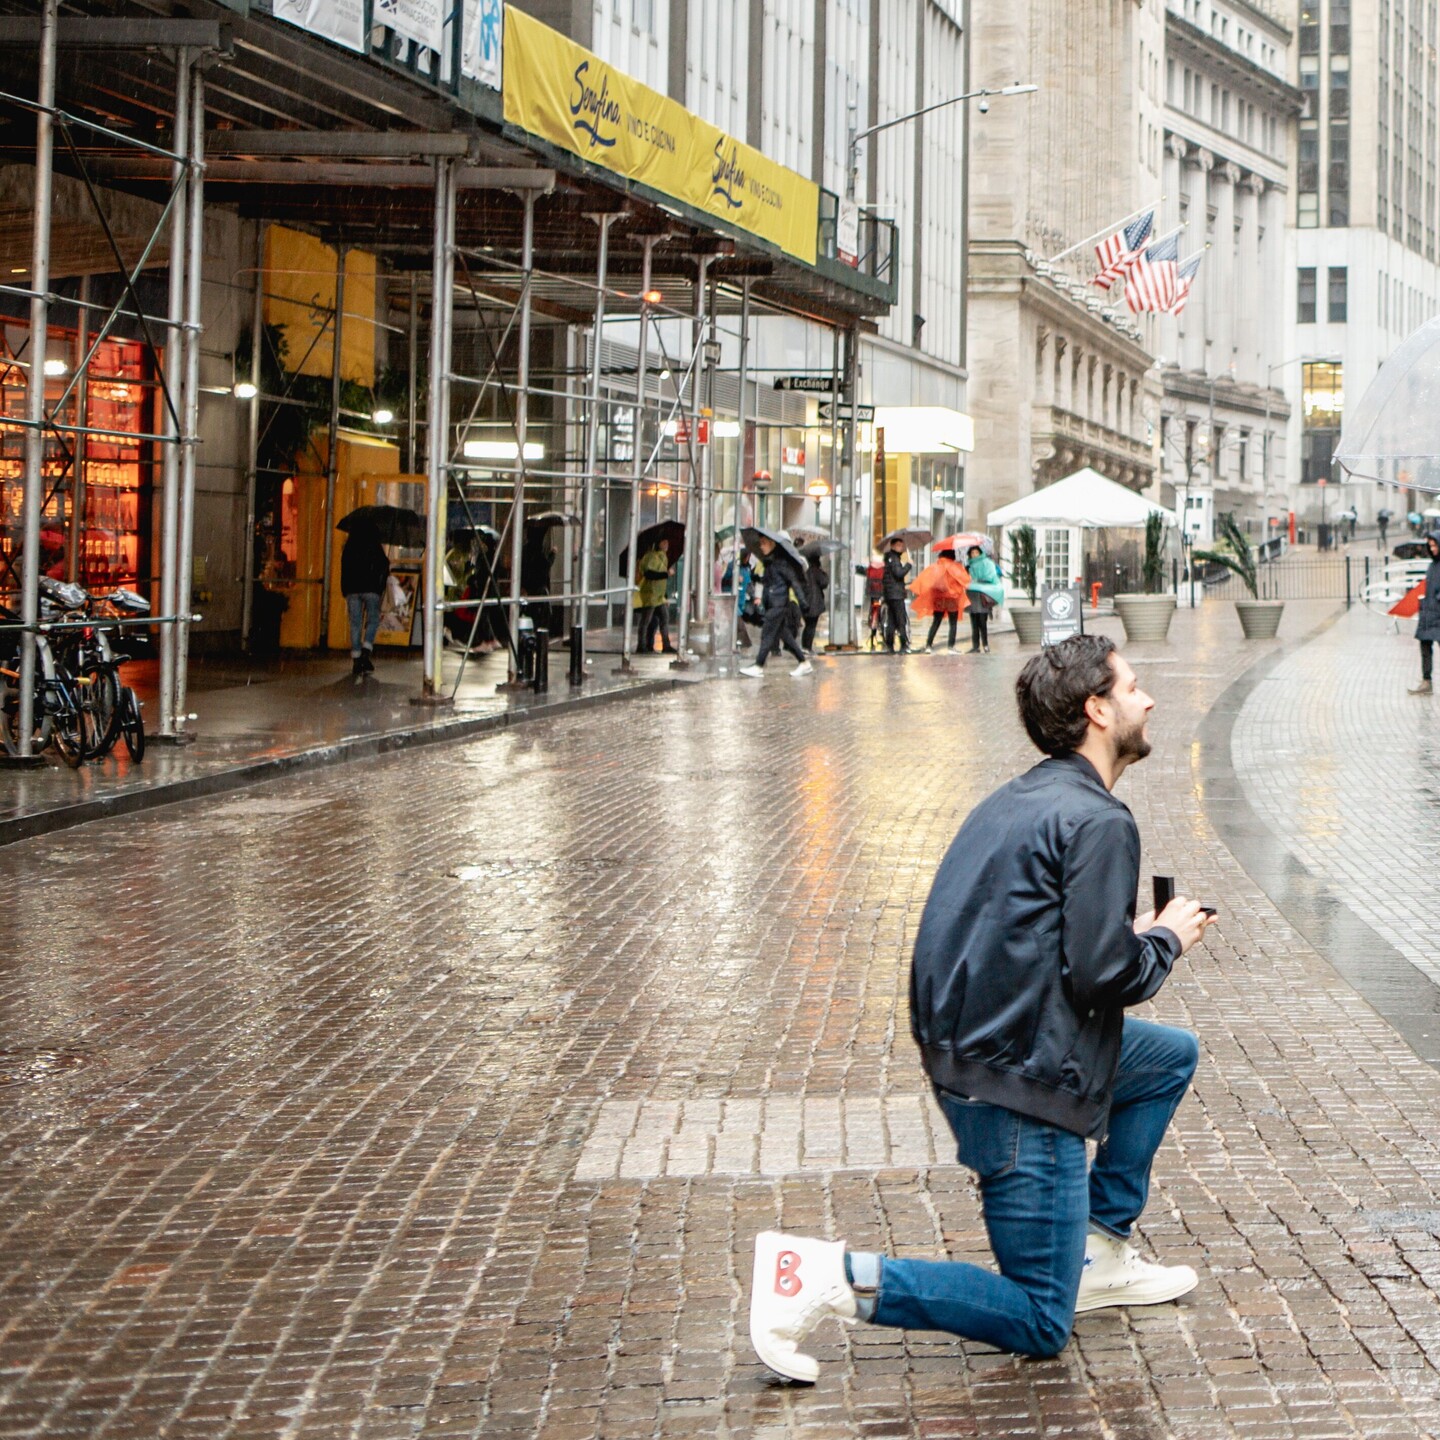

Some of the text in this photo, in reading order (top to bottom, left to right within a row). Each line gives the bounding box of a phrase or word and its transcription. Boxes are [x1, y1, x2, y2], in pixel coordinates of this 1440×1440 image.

[400, 2, 435, 29] MANAGEMENT
[570, 60, 676, 154] Serafina VINO E CUCINA
[794, 378, 829, 390] Exchange
